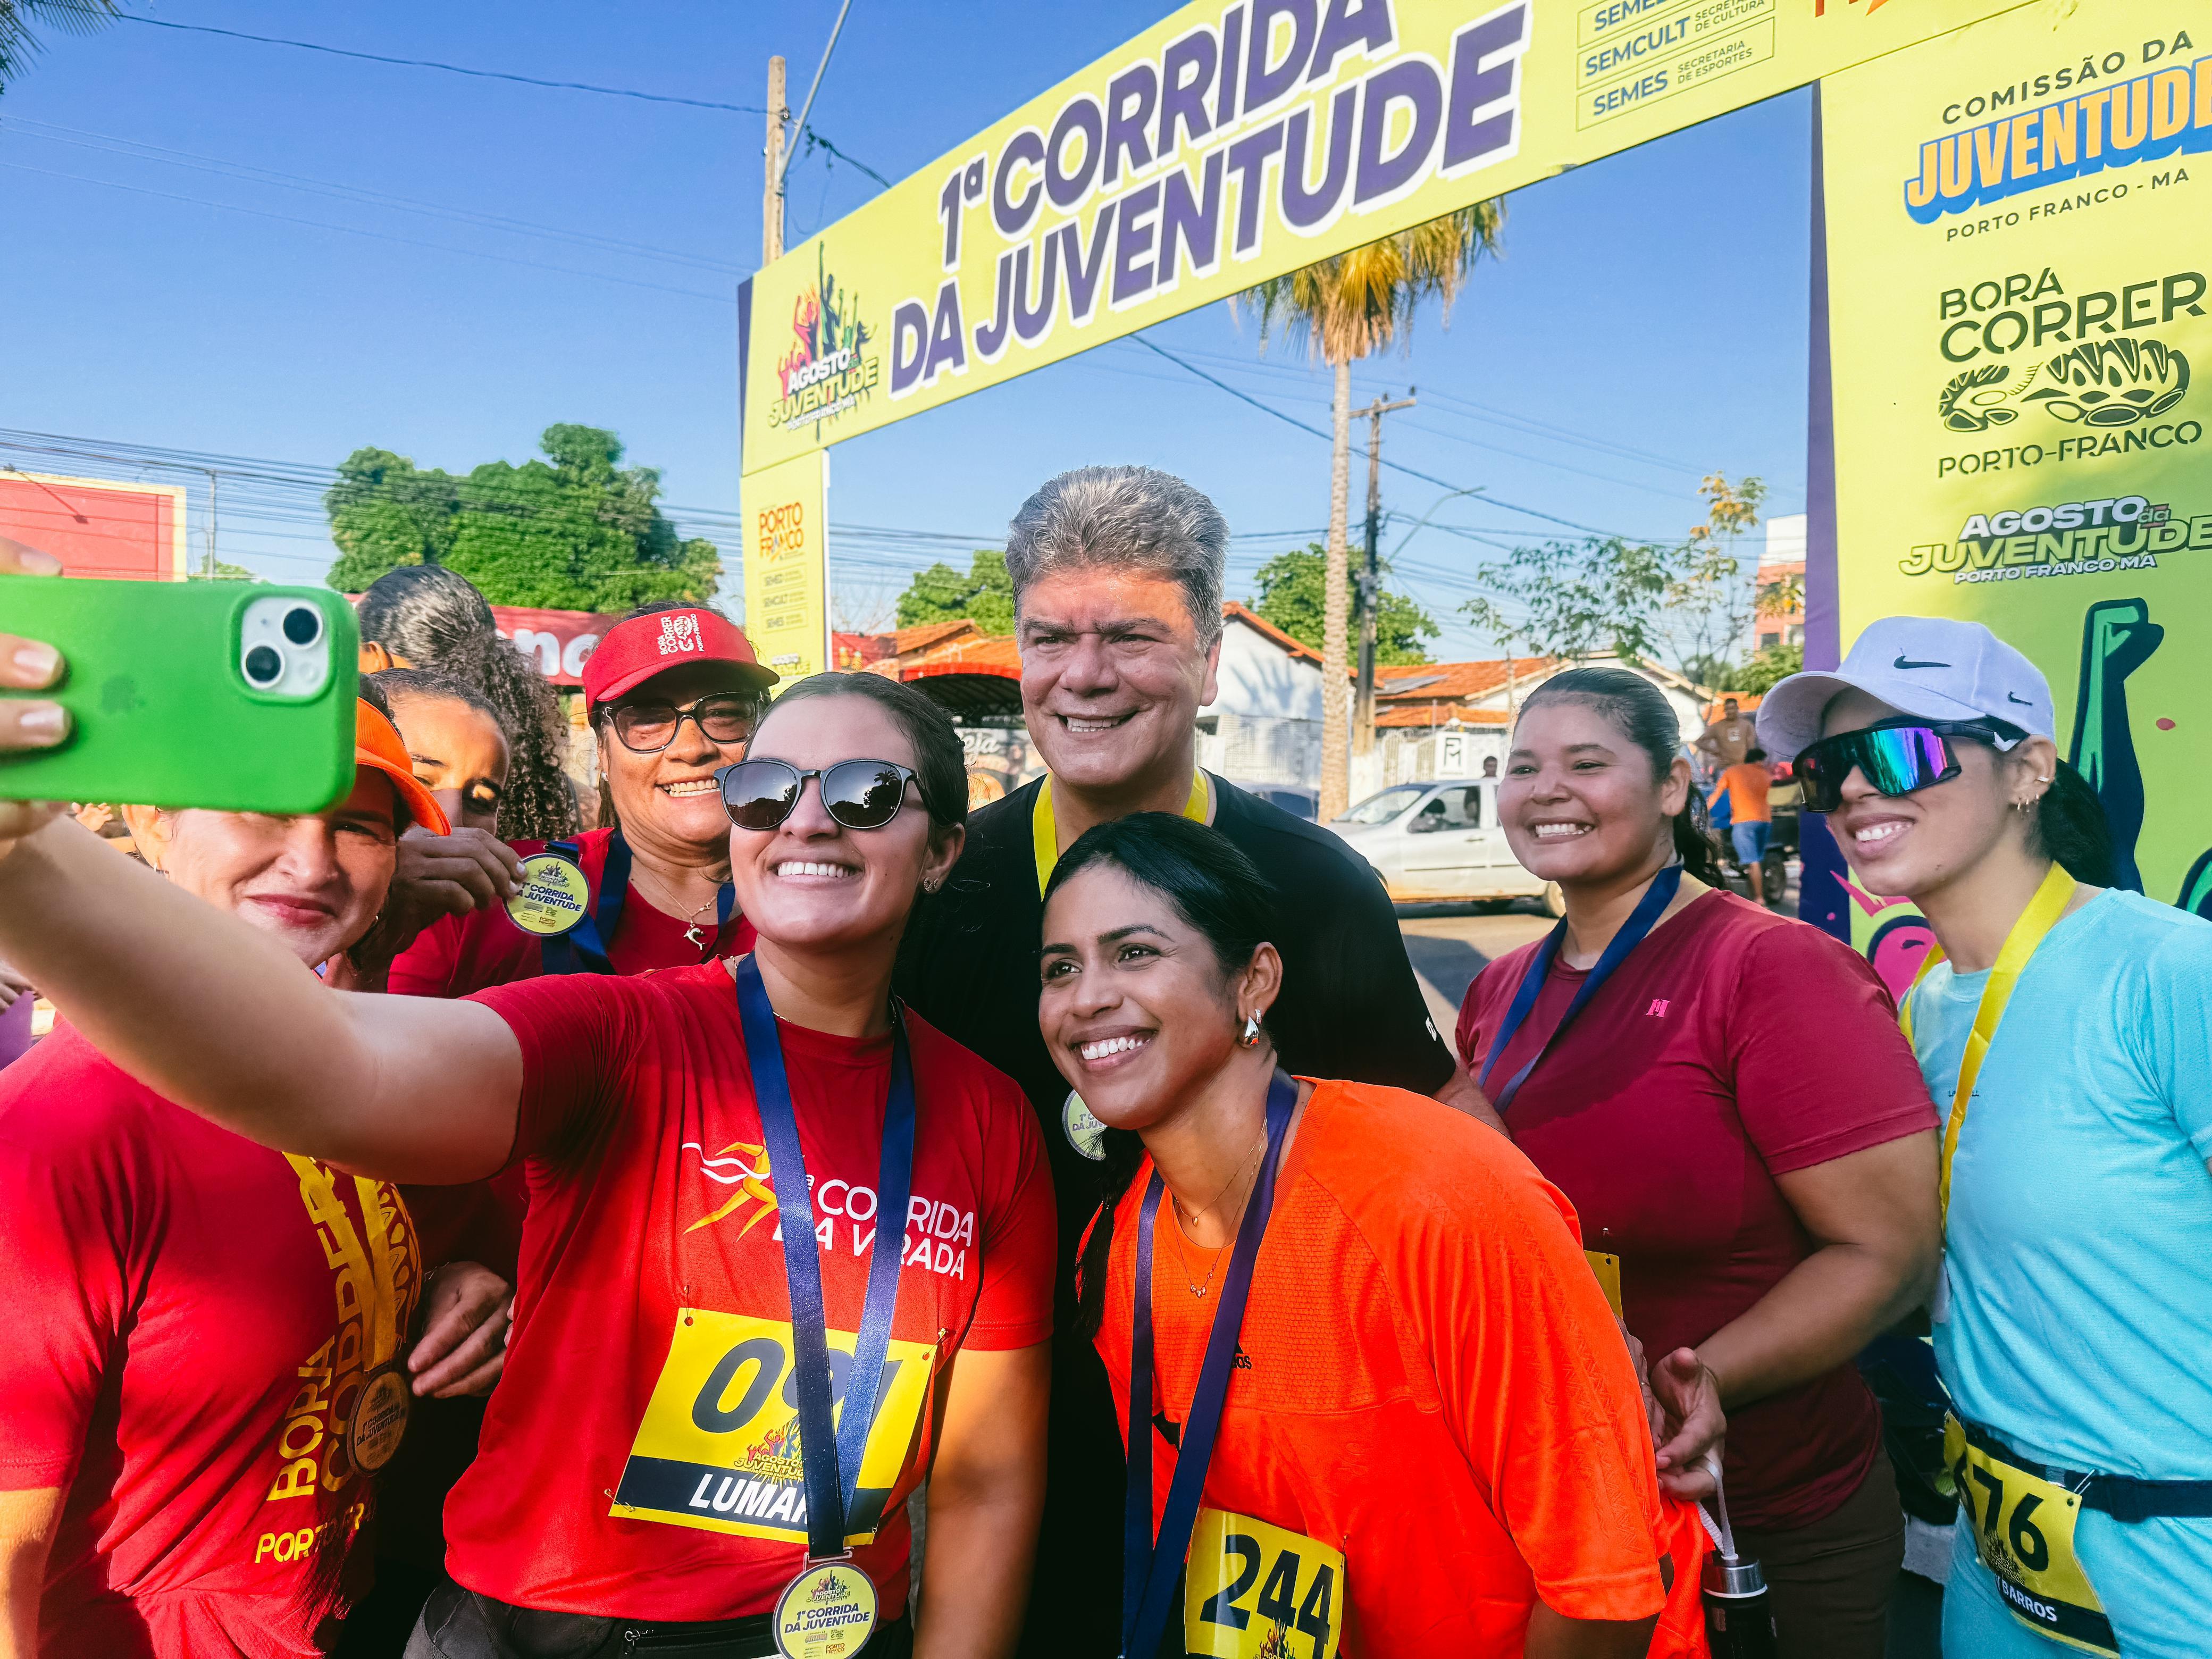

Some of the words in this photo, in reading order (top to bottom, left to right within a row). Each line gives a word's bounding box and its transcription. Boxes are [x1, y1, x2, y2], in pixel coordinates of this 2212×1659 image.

[1594, 0, 1670, 31] SEME
[1695, 20, 1710, 32] DE
[1713, 0, 1765, 24] CULTURA
[1586, 16, 1691, 77] SEMCULT
[1677, 40, 1746, 73] SECRETARIA
[1678, 72, 1692, 84] DE
[1696, 48, 1753, 78] ESPORTES
[1593, 70, 1669, 116] SEMES
[1942, 51, 2126, 125] COMISSÃO
[2142, 30, 2194, 64] DA
[992, 0, 1396, 237] CORRIDA
[889, 279, 965, 396] DA
[974, 2, 1529, 359] JUVENTUDE
[1946, 212, 2020, 242] PORTO
[2029, 183, 2128, 222] FRANCO
[2151, 168, 2190, 190] MA
[1940, 267, 2065, 321] BORA
[1939, 271, 2208, 363] CORRER
[768, 357, 879, 428] JUVENTUDE
[787, 347, 851, 395] AGOSTO
[1937, 420, 2203, 478] PORTO-FRANCO
[759, 501, 802, 536] PORTO
[1958, 496, 2149, 540] AGOSTO
[1898, 514, 2212, 575] JUVENTUDE
[1954, 567, 2021, 585] PORTO
[2025, 557, 2118, 578] FRANCO
[2119, 554, 2156, 569] MA
[657, 635, 668, 655] BORA
[660, 616, 678, 653] CORRER
[524, 892, 583, 911] JUVENTUDE
[530, 884, 574, 902] CORRIDA
[817, 1178, 974, 1248] CORIDA
[266, 1335, 336, 1502] BORA
[752, 1453, 801, 1468] AGOSTO
[806, 1603, 859, 1620] CORRIDA
[1199, 1534, 1335, 1659] 244
[2001, 1579, 2058, 1622] BARROS
[784, 1623, 801, 1634] DA
[802, 1611, 870, 1631] JUVENTUDE
